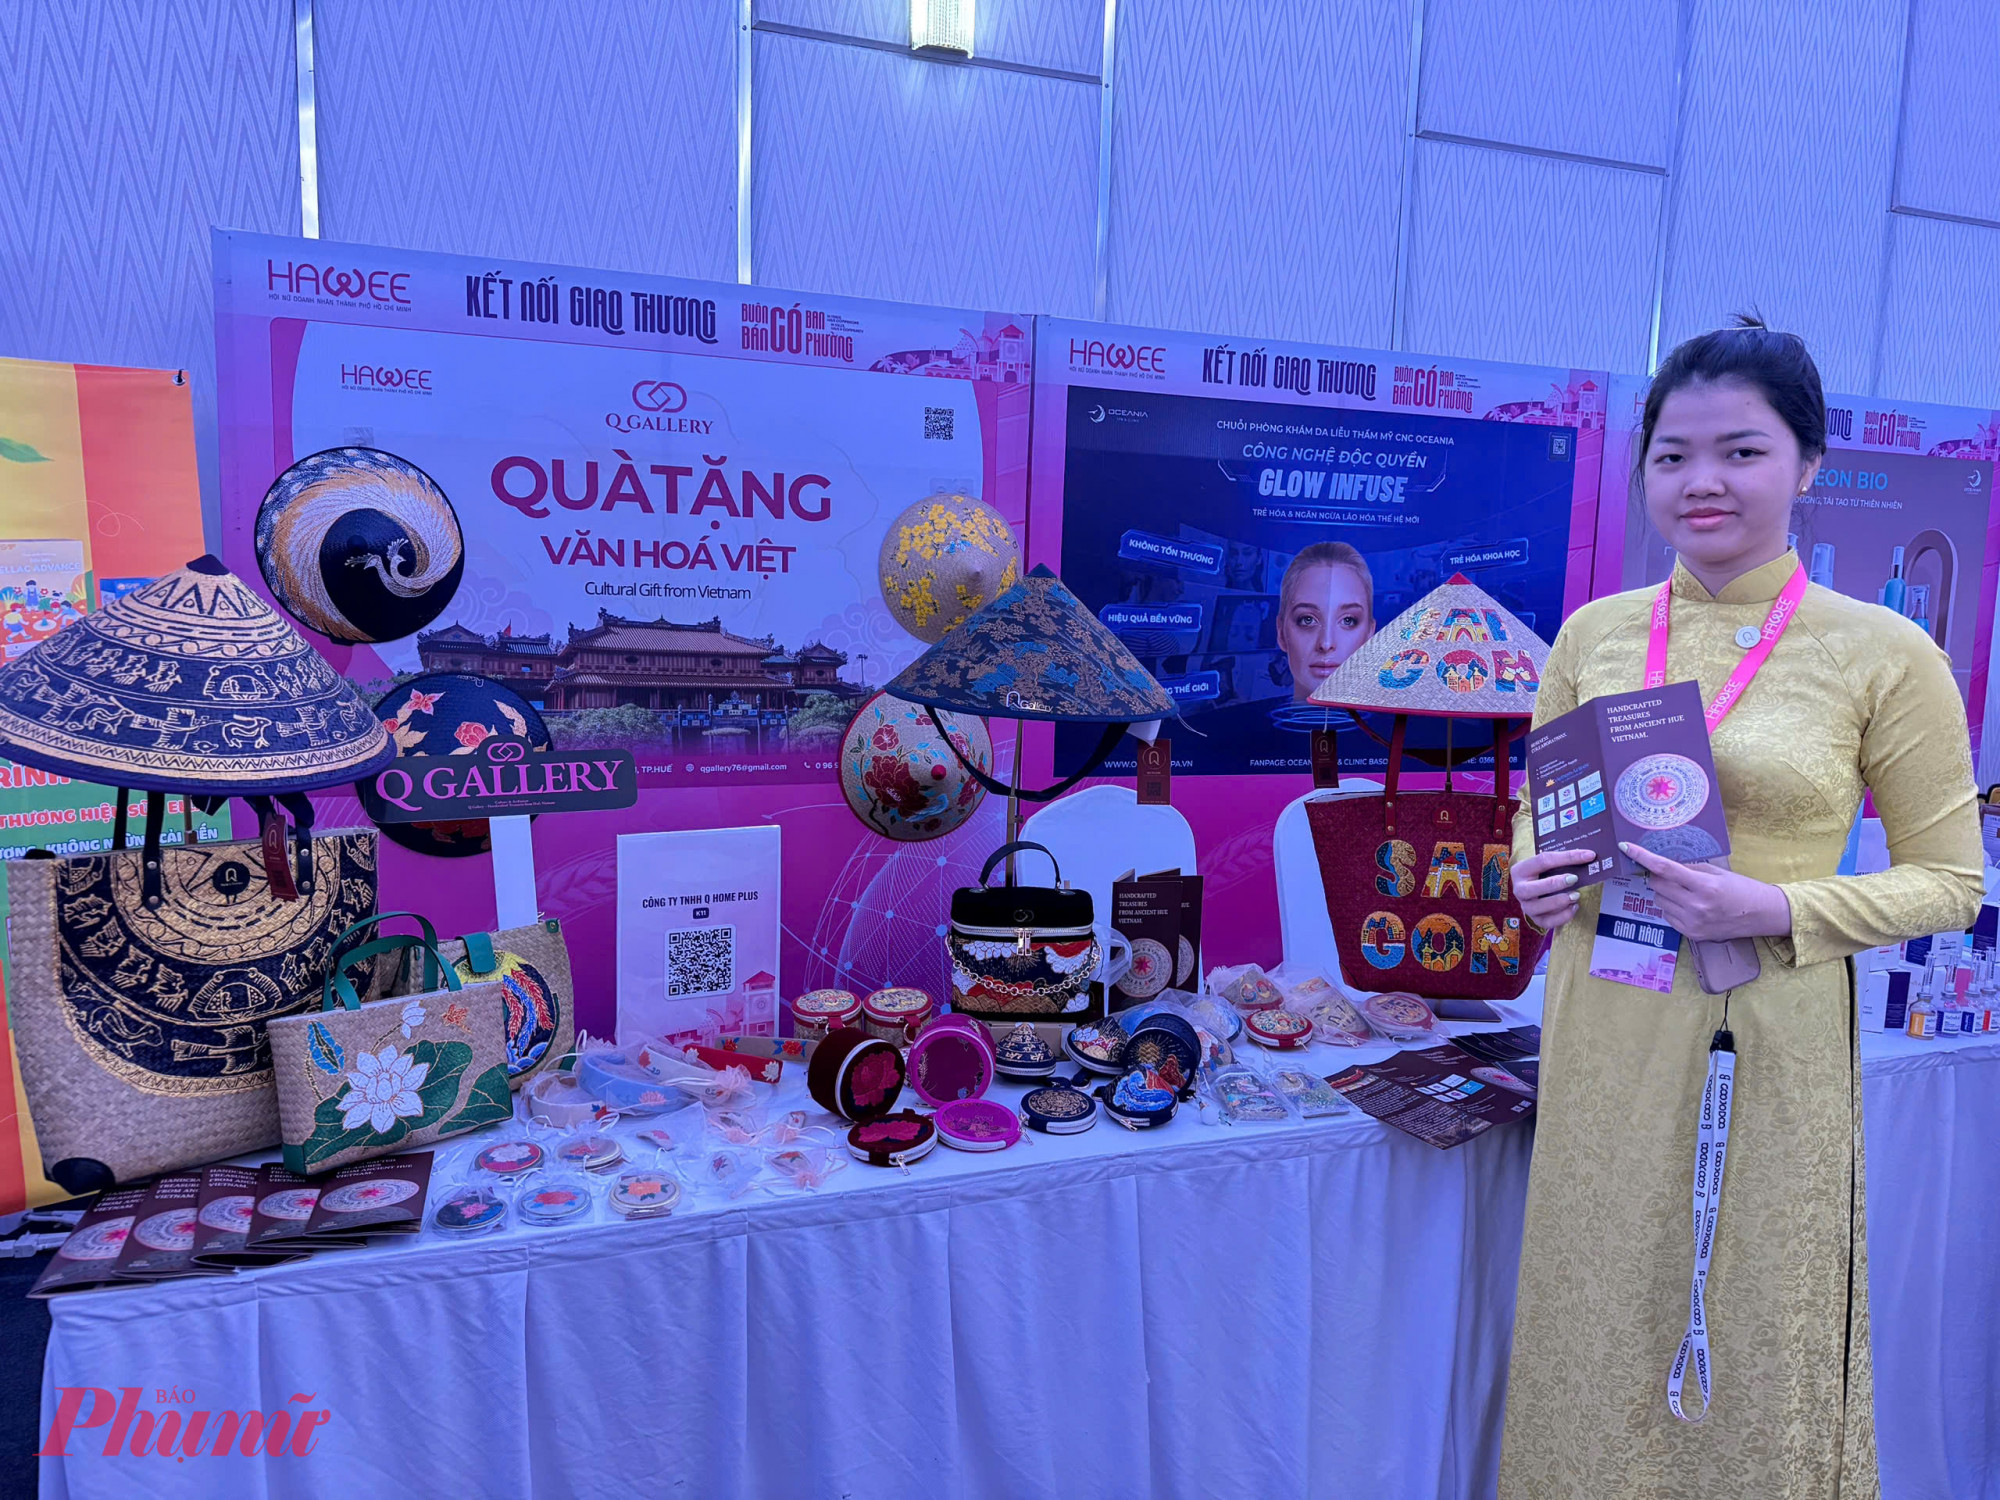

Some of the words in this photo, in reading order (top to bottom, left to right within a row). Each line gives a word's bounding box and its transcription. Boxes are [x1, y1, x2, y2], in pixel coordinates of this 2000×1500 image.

[268, 259, 411, 304] HAWEE
[466, 271, 513, 319] KẾT
[520, 276, 559, 324] NỐI
[569, 285, 625, 336] GIAO
[631, 291, 718, 345] THƯƠNG
[741, 324, 769, 352] BÁN
[770, 303, 802, 354] CÓ
[805, 331, 854, 363] PHƯỜNG
[1069, 338, 1166, 373] HAWEE
[342, 363, 432, 390] HAWEE
[1202, 344, 1236, 385] KẾT
[1239, 347, 1267, 387] NỐI
[1273, 355, 1311, 396] GIAO
[1317, 359, 1377, 401] THƯƠNG
[1413, 364, 1438, 407] CÓ
[605, 413, 631, 433] Q
[626, 414, 714, 435] GALLERY
[1108, 408, 1148, 418] OCEANIA
[1249, 421, 1283, 434] PHÒNG
[1285, 424, 1313, 436] KHÁM
[1315, 428, 1329, 437] DA
[1395, 433, 1414, 443] CNC
[1415, 435, 1455, 446] OCEANIA
[1242, 441, 1288, 460] CÔNG
[1291, 446, 1336, 466] NGHỆ
[1338, 448, 1373, 468] ĐỘC
[1375, 451, 1428, 469] QUYỀN
[1258, 468, 1327, 499] GLOW
[1328, 472, 1409, 504] INFUSE
[1857, 471, 1889, 491] BIO
[1288, 510, 1294, 518] &
[540, 529, 625, 567] VĂN
[634, 535, 718, 571] HOÁ
[720, 537, 797, 580] VIỆT
[1129, 539, 1160, 553] KHÔNG
[1179, 550, 1214, 565] THƯƠNG
[1482, 551, 1504, 561] KHOA
[585, 581, 637, 596] Cultural
[639, 582, 663, 597] Gift
[664, 583, 696, 598] from
[698, 585, 751, 600] Vietnam
[1761, 596, 1792, 641] HAWEE
[1607, 699, 1662, 714] HANDCRAFTED
[1704, 679, 1740, 720] HAWEE
[1608, 711, 1650, 723] TREASURES
[1610, 724, 1632, 733] FROM
[1633, 718, 1666, 730] ANCIENT
[1611, 731, 1648, 743] VIETNAM.
[700, 763, 787, 773] qgallery76@gmail.com
[1250, 759, 1287, 767] FANPAGE:
[1343, 758, 1367, 766] CLINIC
[376, 769, 423, 812] Q
[423, 760, 624, 799] GALLERY
[642, 896, 666, 909] CÔNG
[668, 896, 678, 906] TY
[680, 894, 702, 906] TNHH
[704, 894, 711, 905] Q
[712, 892, 736, 903] HOME
[737, 891, 759, 902] PLUS
[1613, 920, 1636, 940] GIAN
[1638, 925, 1665, 948] HÀNG
